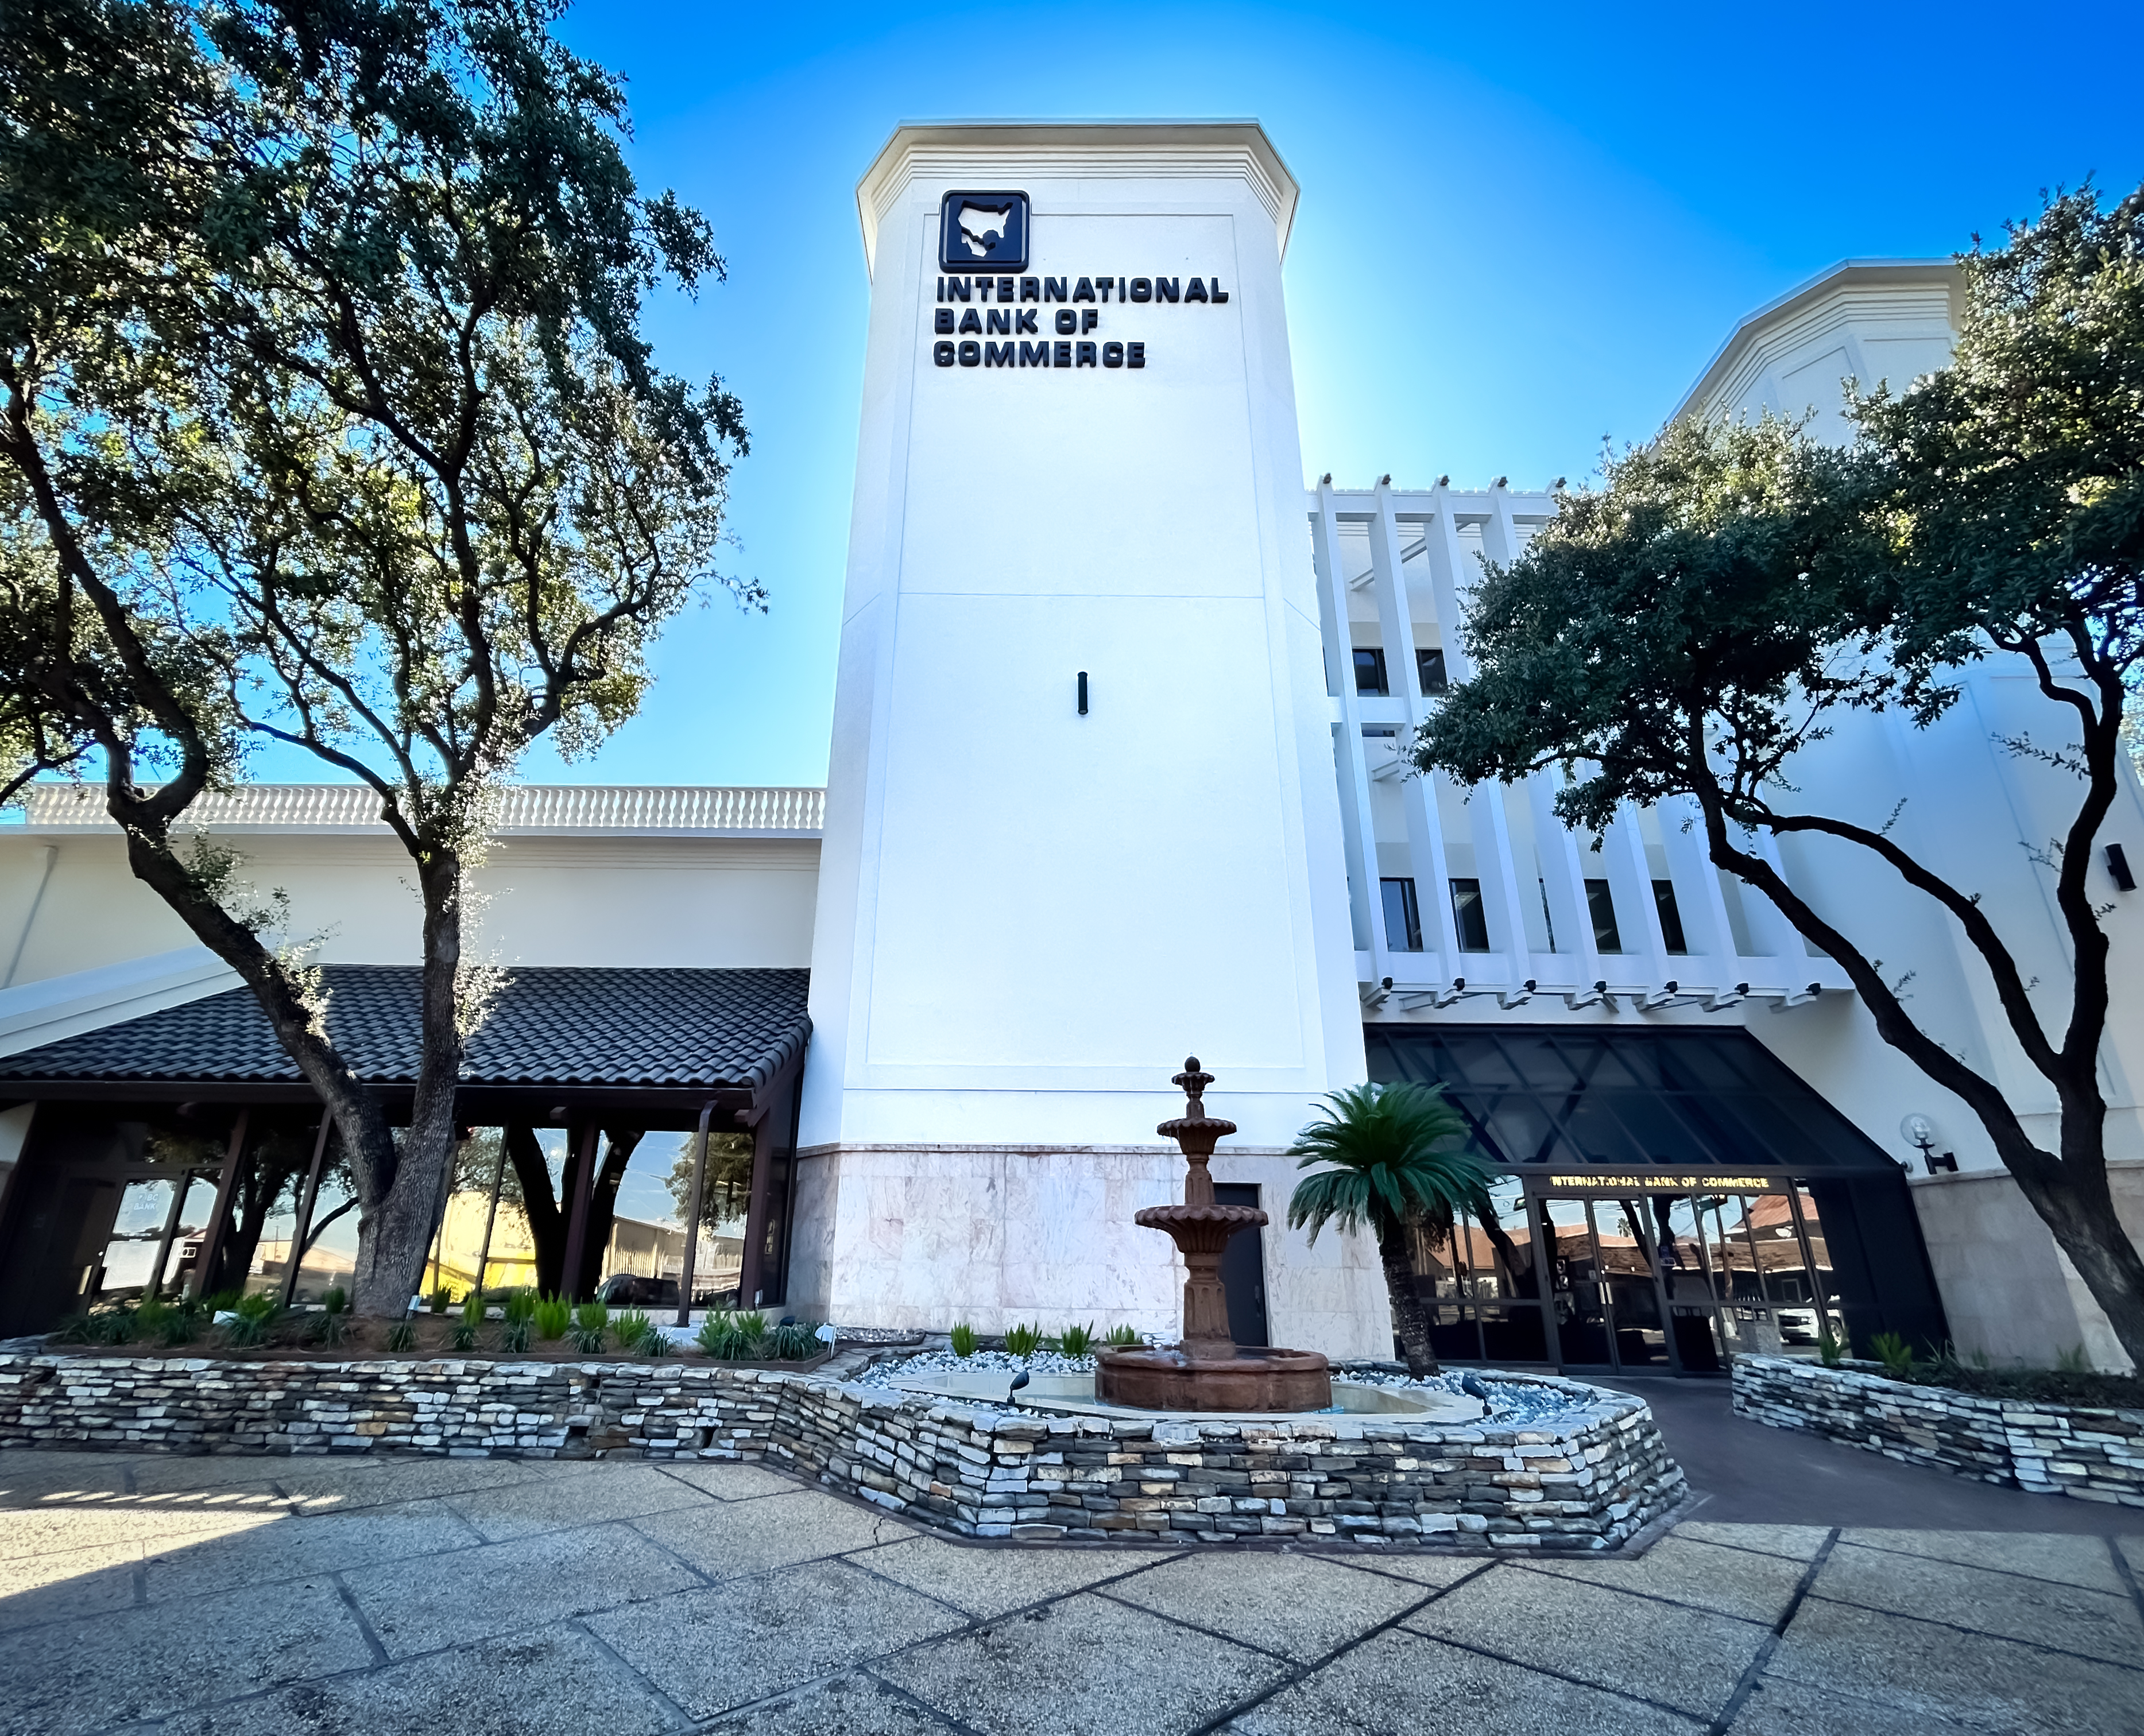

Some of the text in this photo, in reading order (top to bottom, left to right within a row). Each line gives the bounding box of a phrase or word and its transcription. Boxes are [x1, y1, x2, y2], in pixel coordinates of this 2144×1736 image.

[936, 276, 1229, 303] INTERNATIONAL
[934, 308, 1098, 335] BANK OF
[933, 340, 1146, 368] COMMERCE
[1644, 1177, 1678, 1187] BANK
[1681, 1177, 1697, 1187] OF
[1701, 1177, 1770, 1188] COMMERCE
